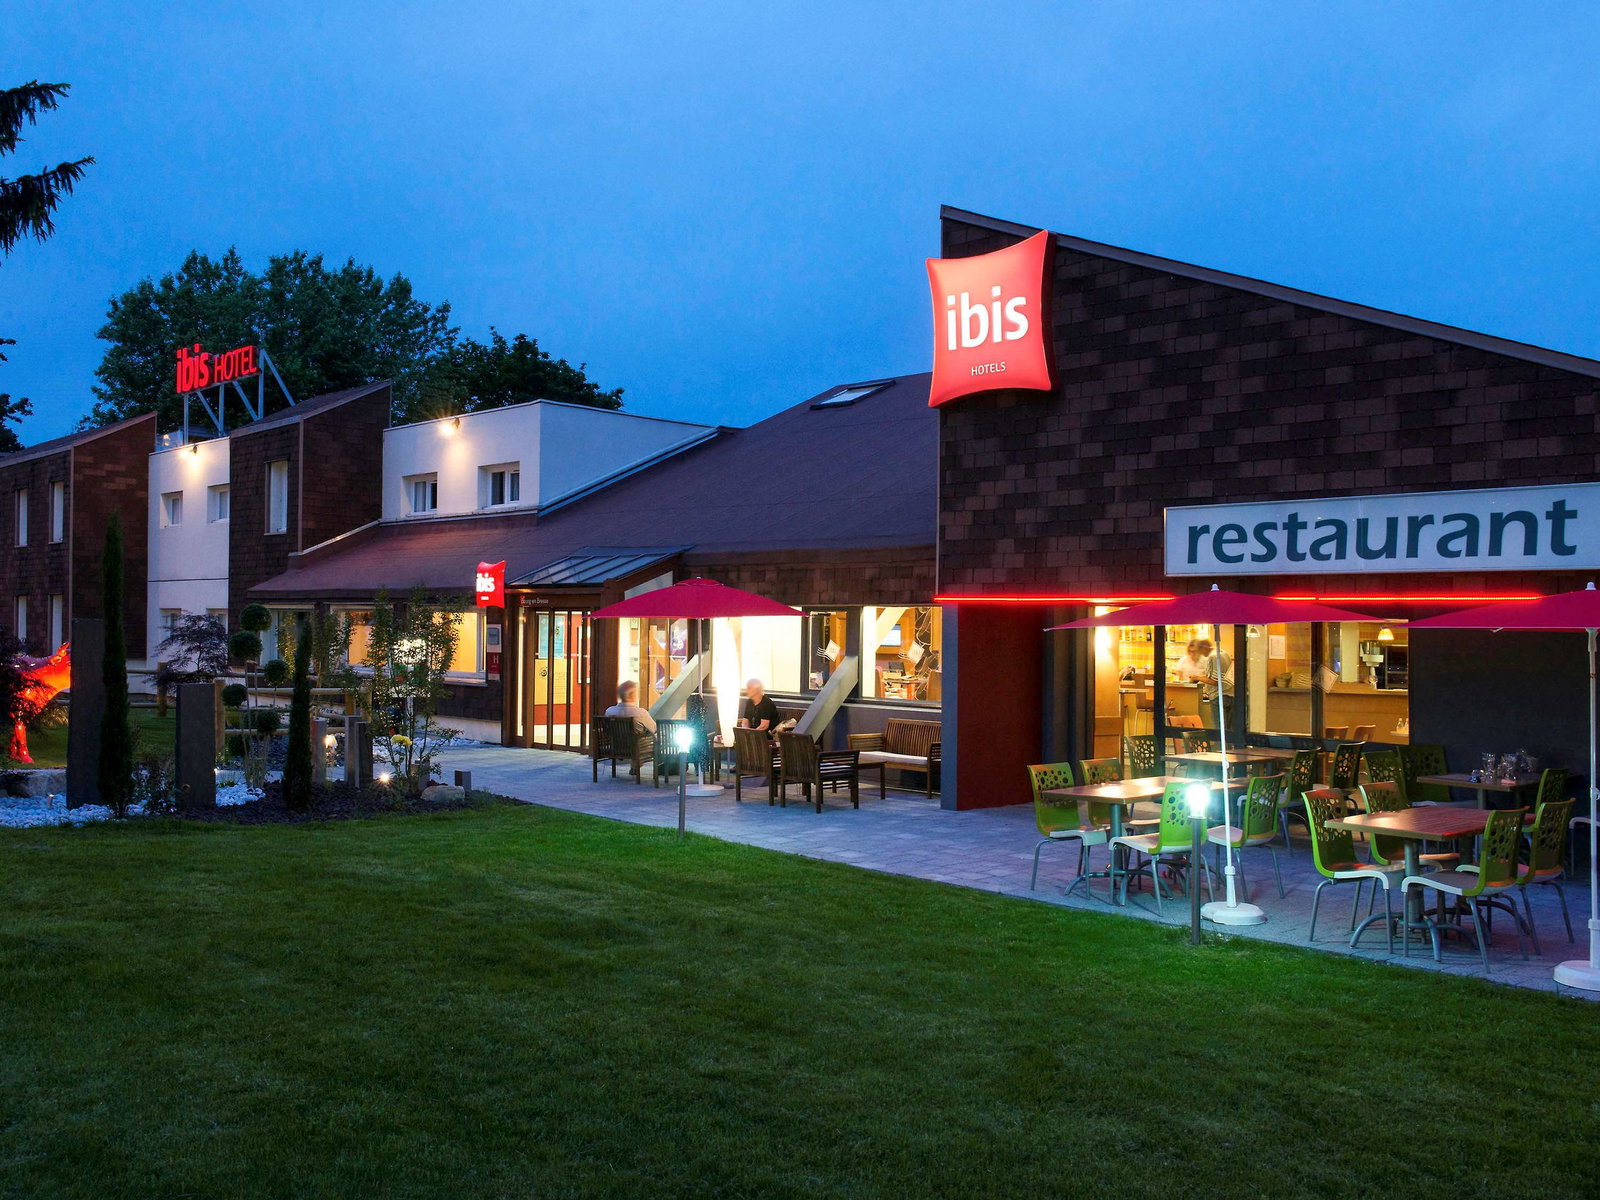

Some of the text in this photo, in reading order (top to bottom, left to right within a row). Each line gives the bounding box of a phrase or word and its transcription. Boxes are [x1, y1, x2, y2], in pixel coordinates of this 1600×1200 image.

[946, 286, 1029, 351] ibis
[176, 343, 257, 393] ibis HOTEL
[971, 361, 1006, 376] HOTELS
[1187, 498, 1578, 564] restaurant
[476, 573, 495, 592] ibis
